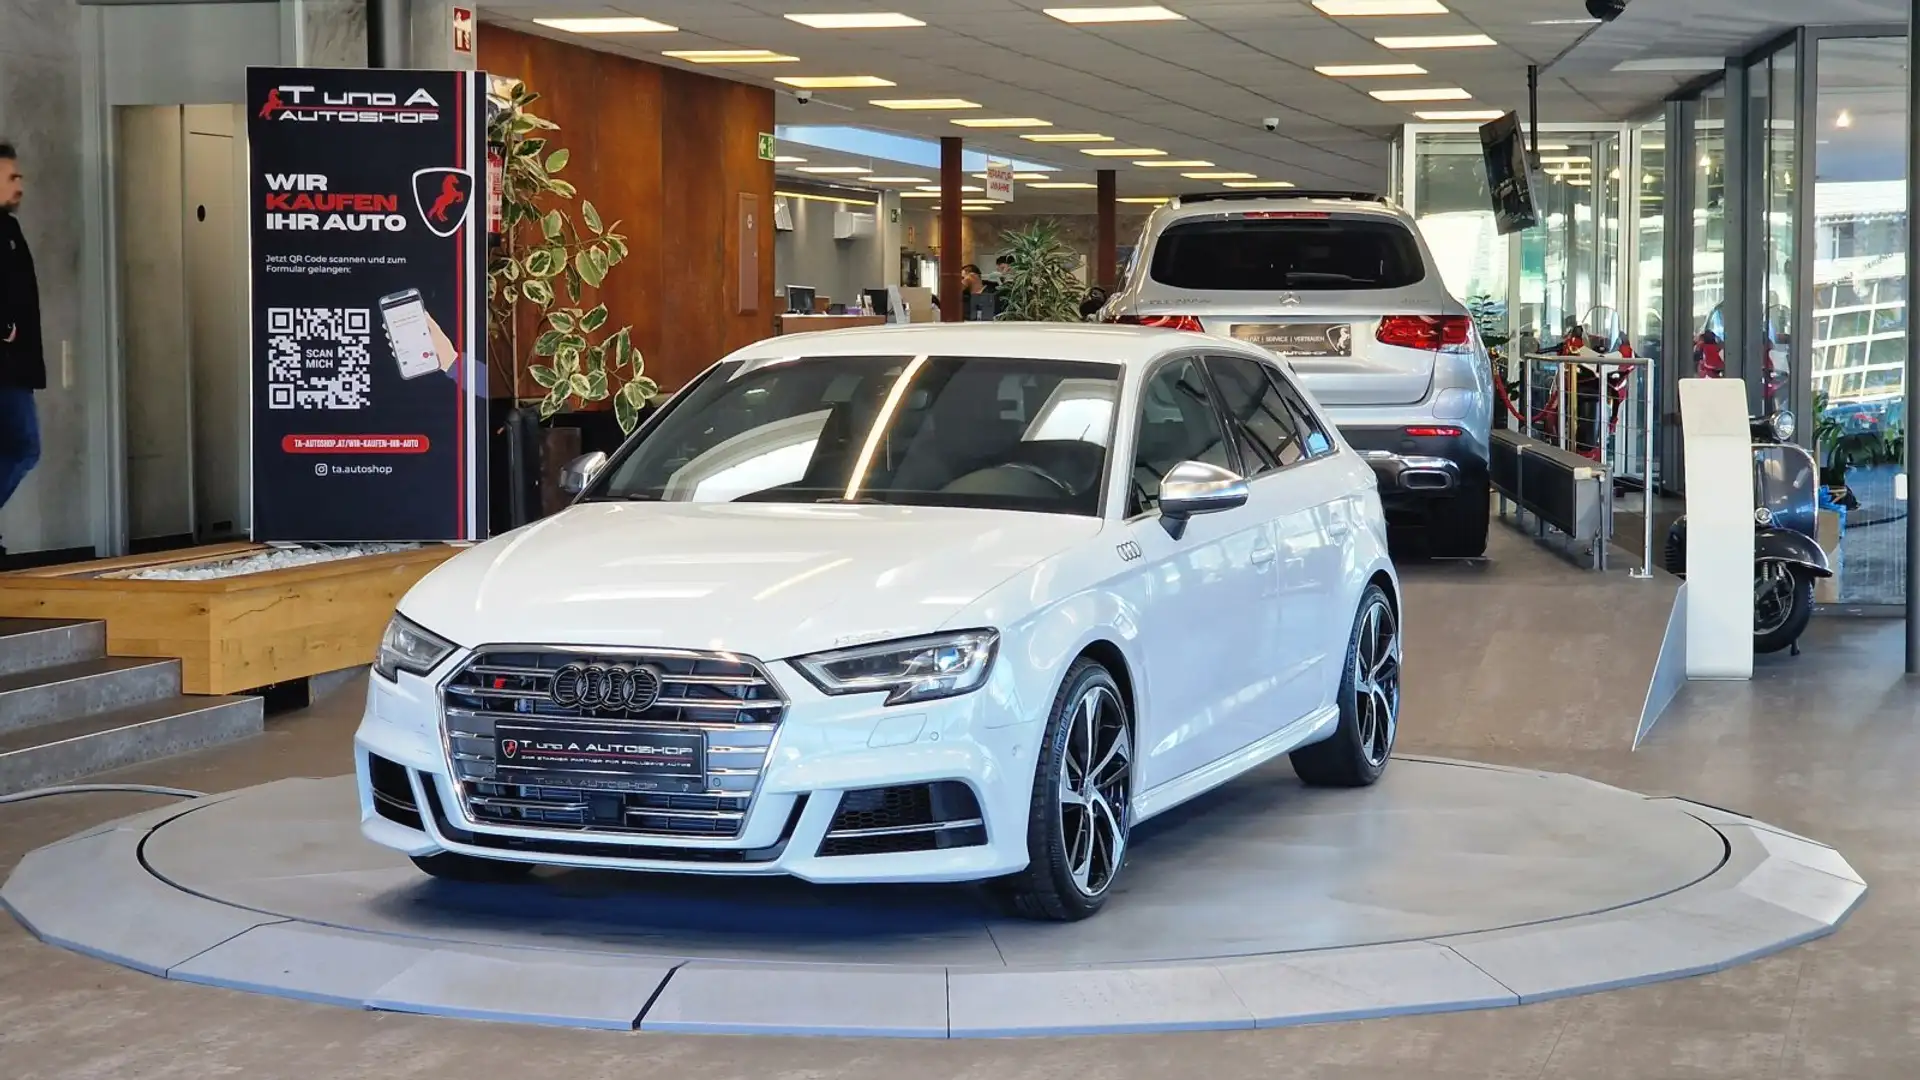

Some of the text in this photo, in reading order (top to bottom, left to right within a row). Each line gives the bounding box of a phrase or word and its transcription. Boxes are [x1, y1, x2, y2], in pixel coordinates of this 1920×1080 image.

[279, 85, 315, 104] T
[404, 88, 439, 106] A
[279, 110, 440, 123] AUTOSHOP
[265, 173, 328, 191] WIR
[266, 193, 398, 212] KAUFEN
[266, 213, 407, 232] IHR AUTO
[266, 254, 407, 264] Jetzt QR Code scannen und zum
[266, 264, 352, 275] Formular gelangen:
[306, 349, 334, 358] SCAN
[306, 359, 334, 369] MICH
[331, 464, 393, 475] ta.autoshop
[520, 740, 532, 748] T
[585, 743, 693, 755] AUTOSHOP
